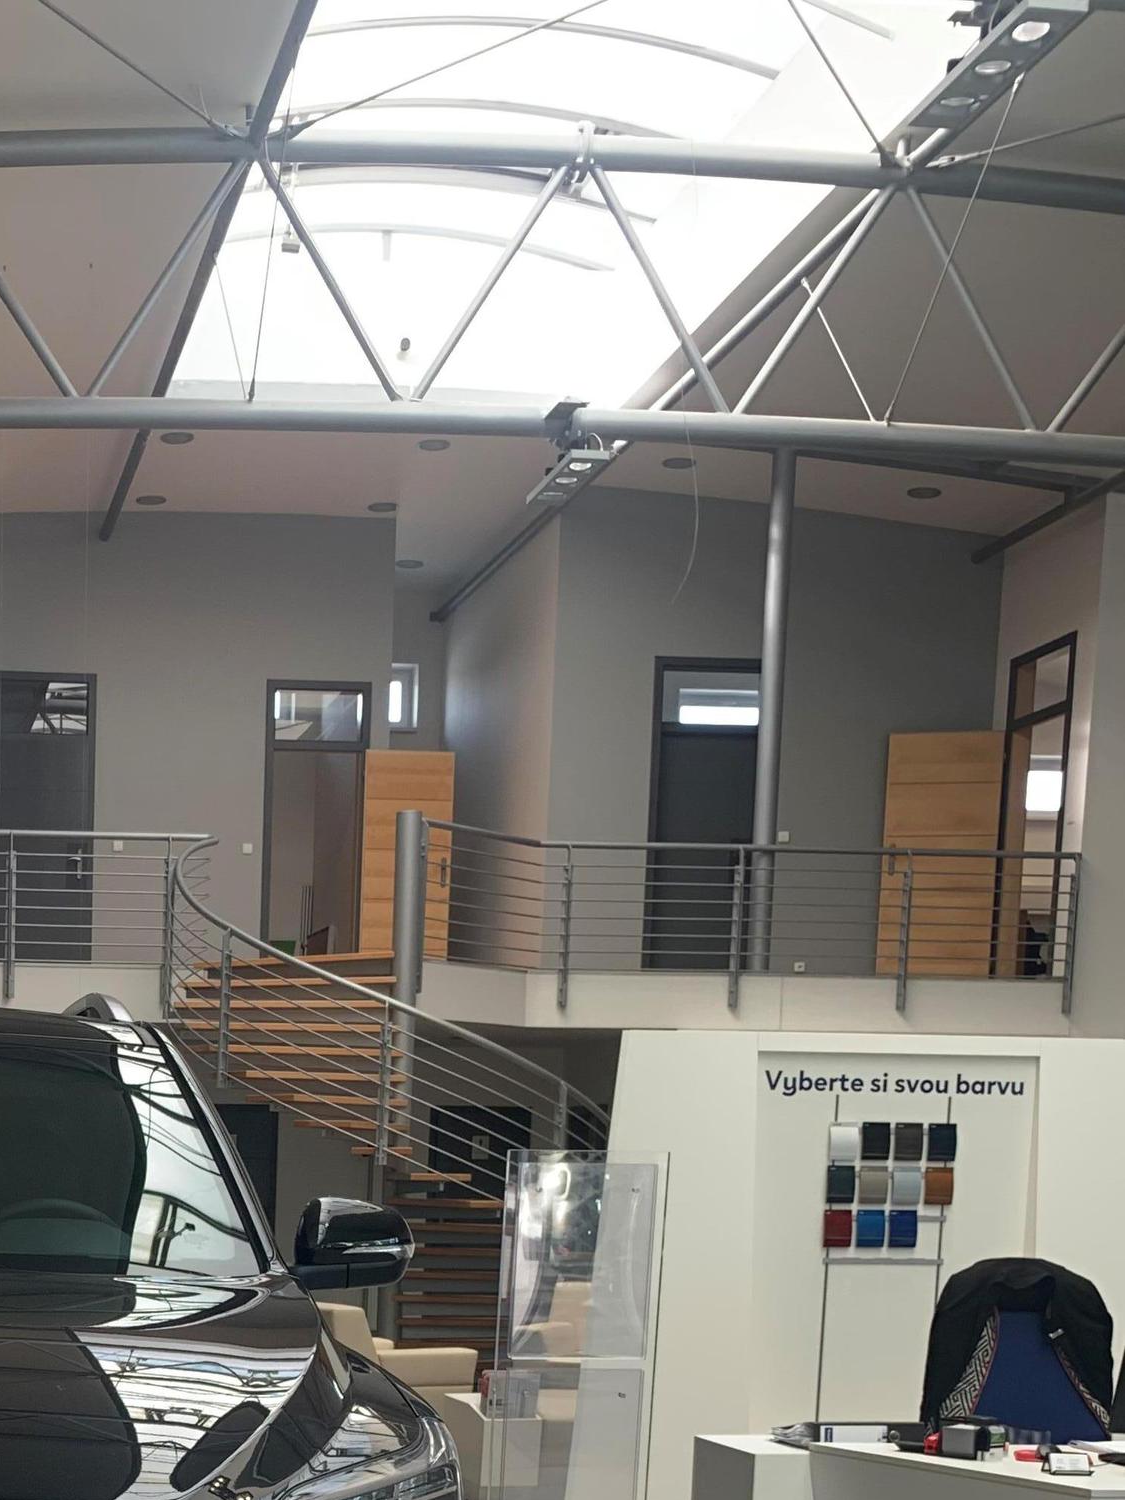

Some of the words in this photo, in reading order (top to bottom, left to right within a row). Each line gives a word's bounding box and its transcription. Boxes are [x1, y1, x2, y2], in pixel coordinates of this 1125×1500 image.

[765, 1070, 864, 1096] Vyberte
[870, 1073, 888, 1093] si
[894, 1079, 949, 1094] svou
[956, 1074, 1025, 1096] barvu
